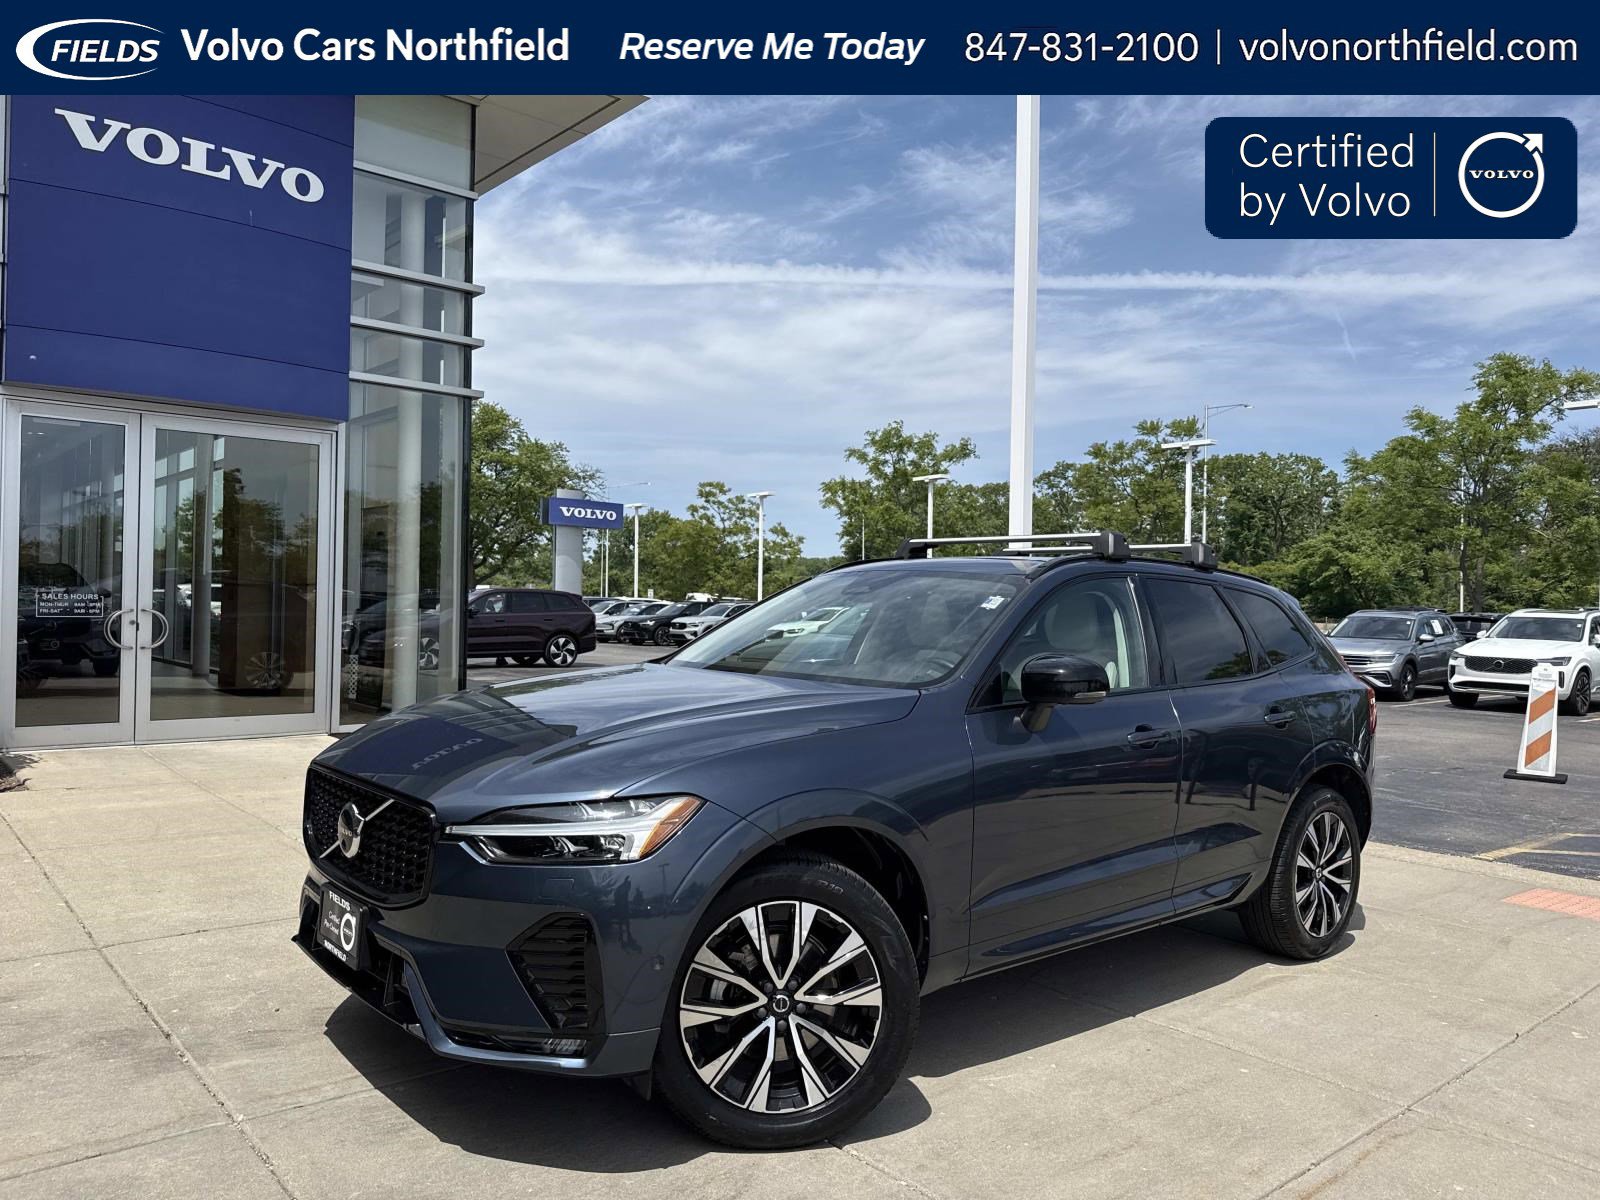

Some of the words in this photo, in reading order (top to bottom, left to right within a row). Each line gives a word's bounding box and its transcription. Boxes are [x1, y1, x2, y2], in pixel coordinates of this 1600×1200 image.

[54, 108, 325, 203] VOLVO
[560, 506, 616, 520] VOLVO
[329, 891, 350, 911] FIELDS
